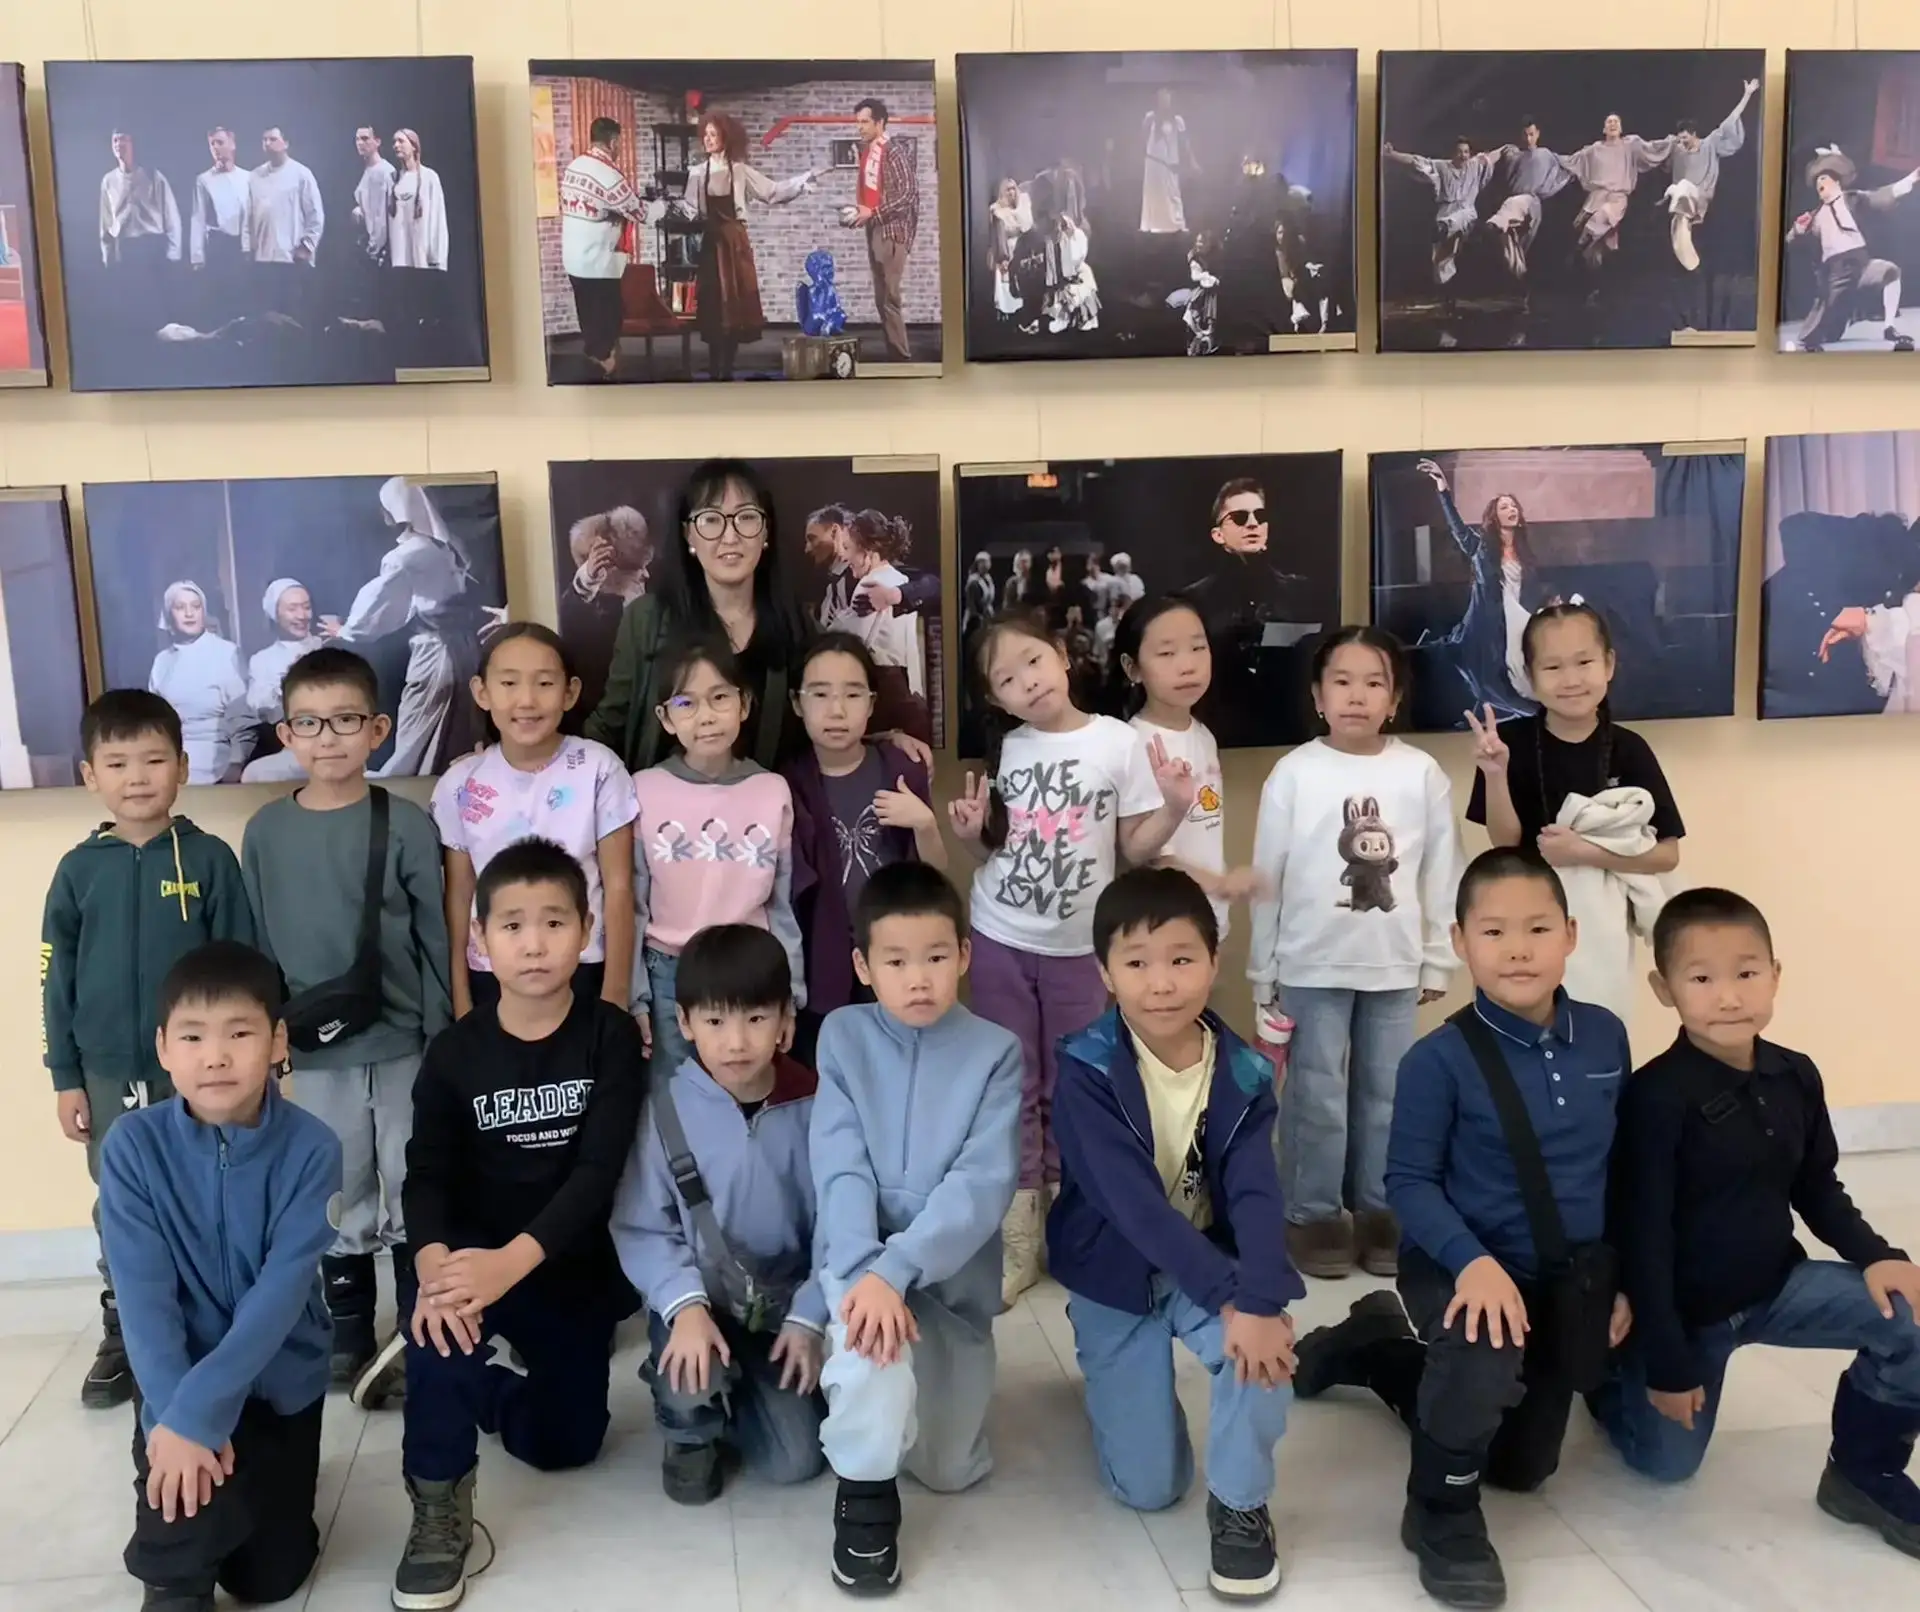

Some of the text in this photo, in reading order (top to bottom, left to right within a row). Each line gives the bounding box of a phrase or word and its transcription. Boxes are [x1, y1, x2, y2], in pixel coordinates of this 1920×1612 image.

[996, 879, 1081, 920] LOVE
[506, 1132, 537, 1142] FOCUS
[539, 1129, 559, 1140] AND
